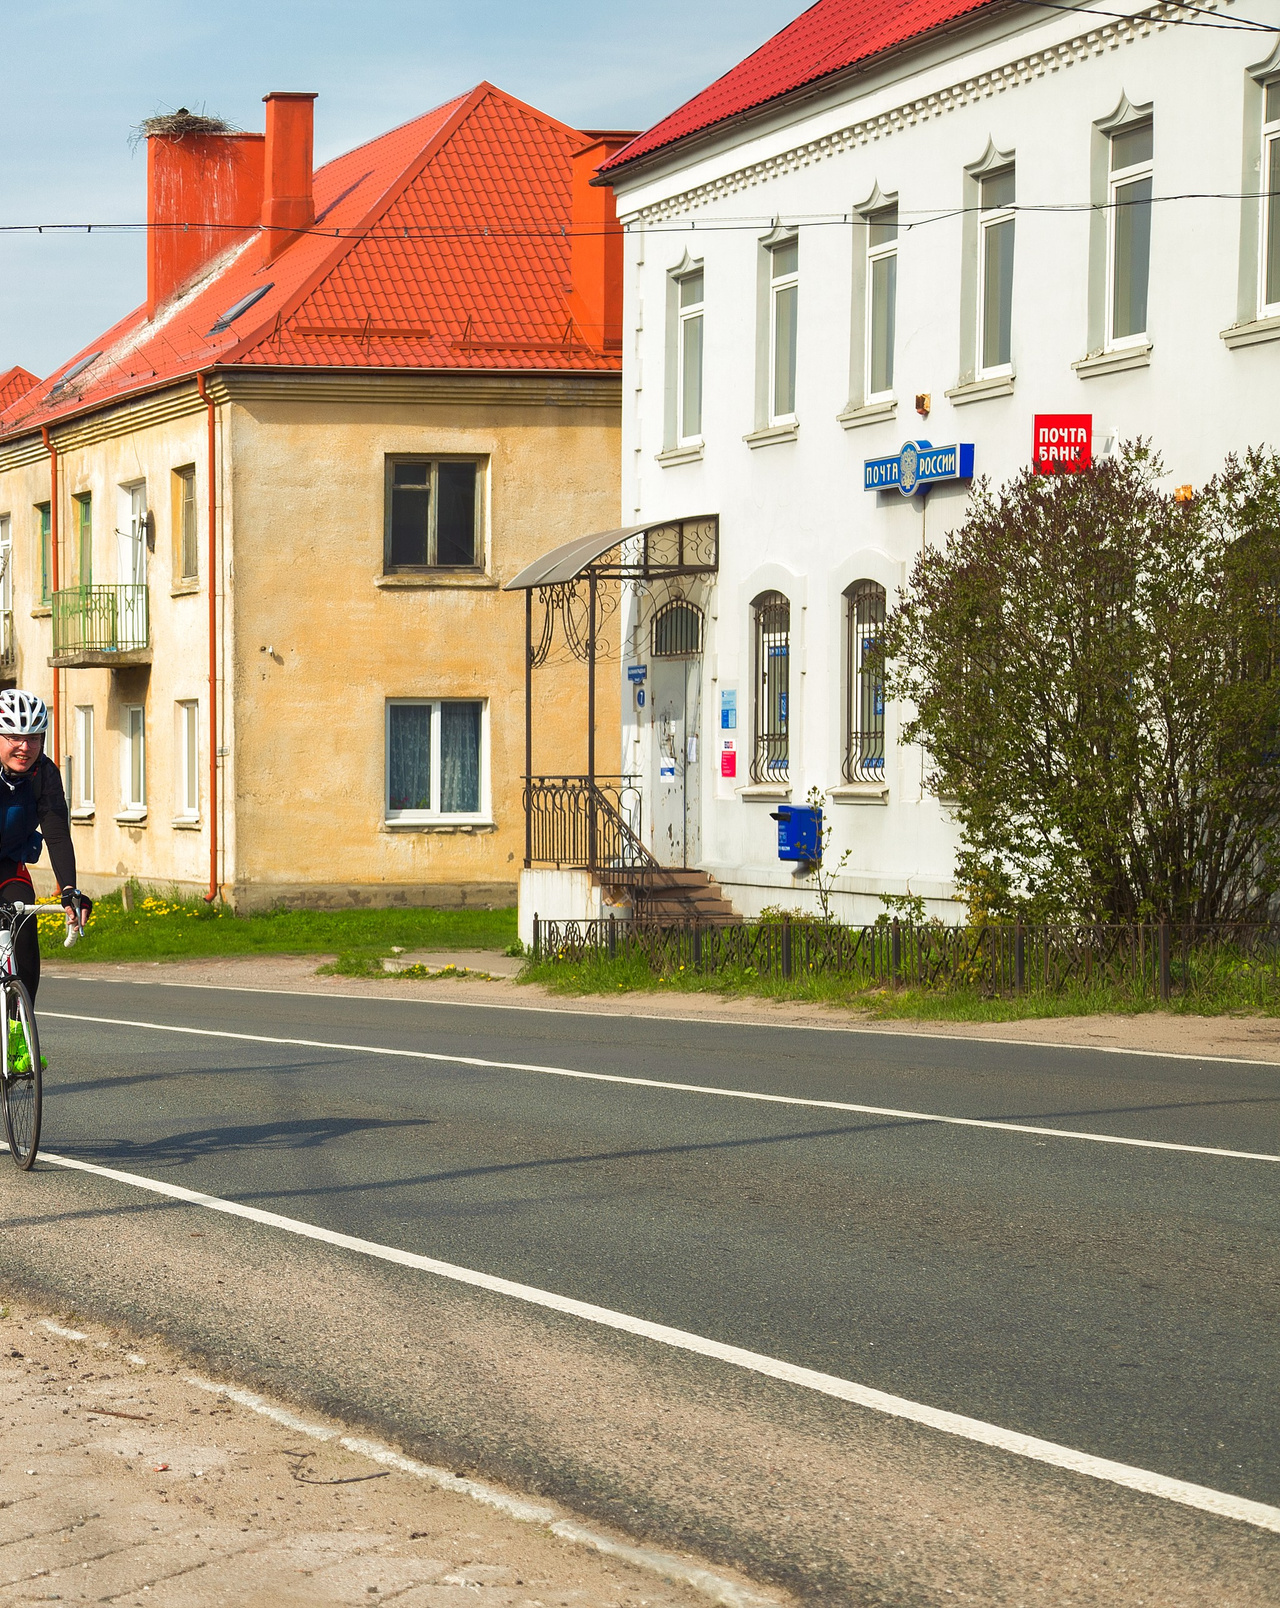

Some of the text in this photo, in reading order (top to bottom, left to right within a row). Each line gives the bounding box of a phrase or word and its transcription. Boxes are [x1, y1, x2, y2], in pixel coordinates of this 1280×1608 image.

[1039, 427, 1087, 443] ПОЧТА
[1038, 446, 1081, 462] БАНК
[866, 453, 955, 485] ПОЧТА РОССИИ
